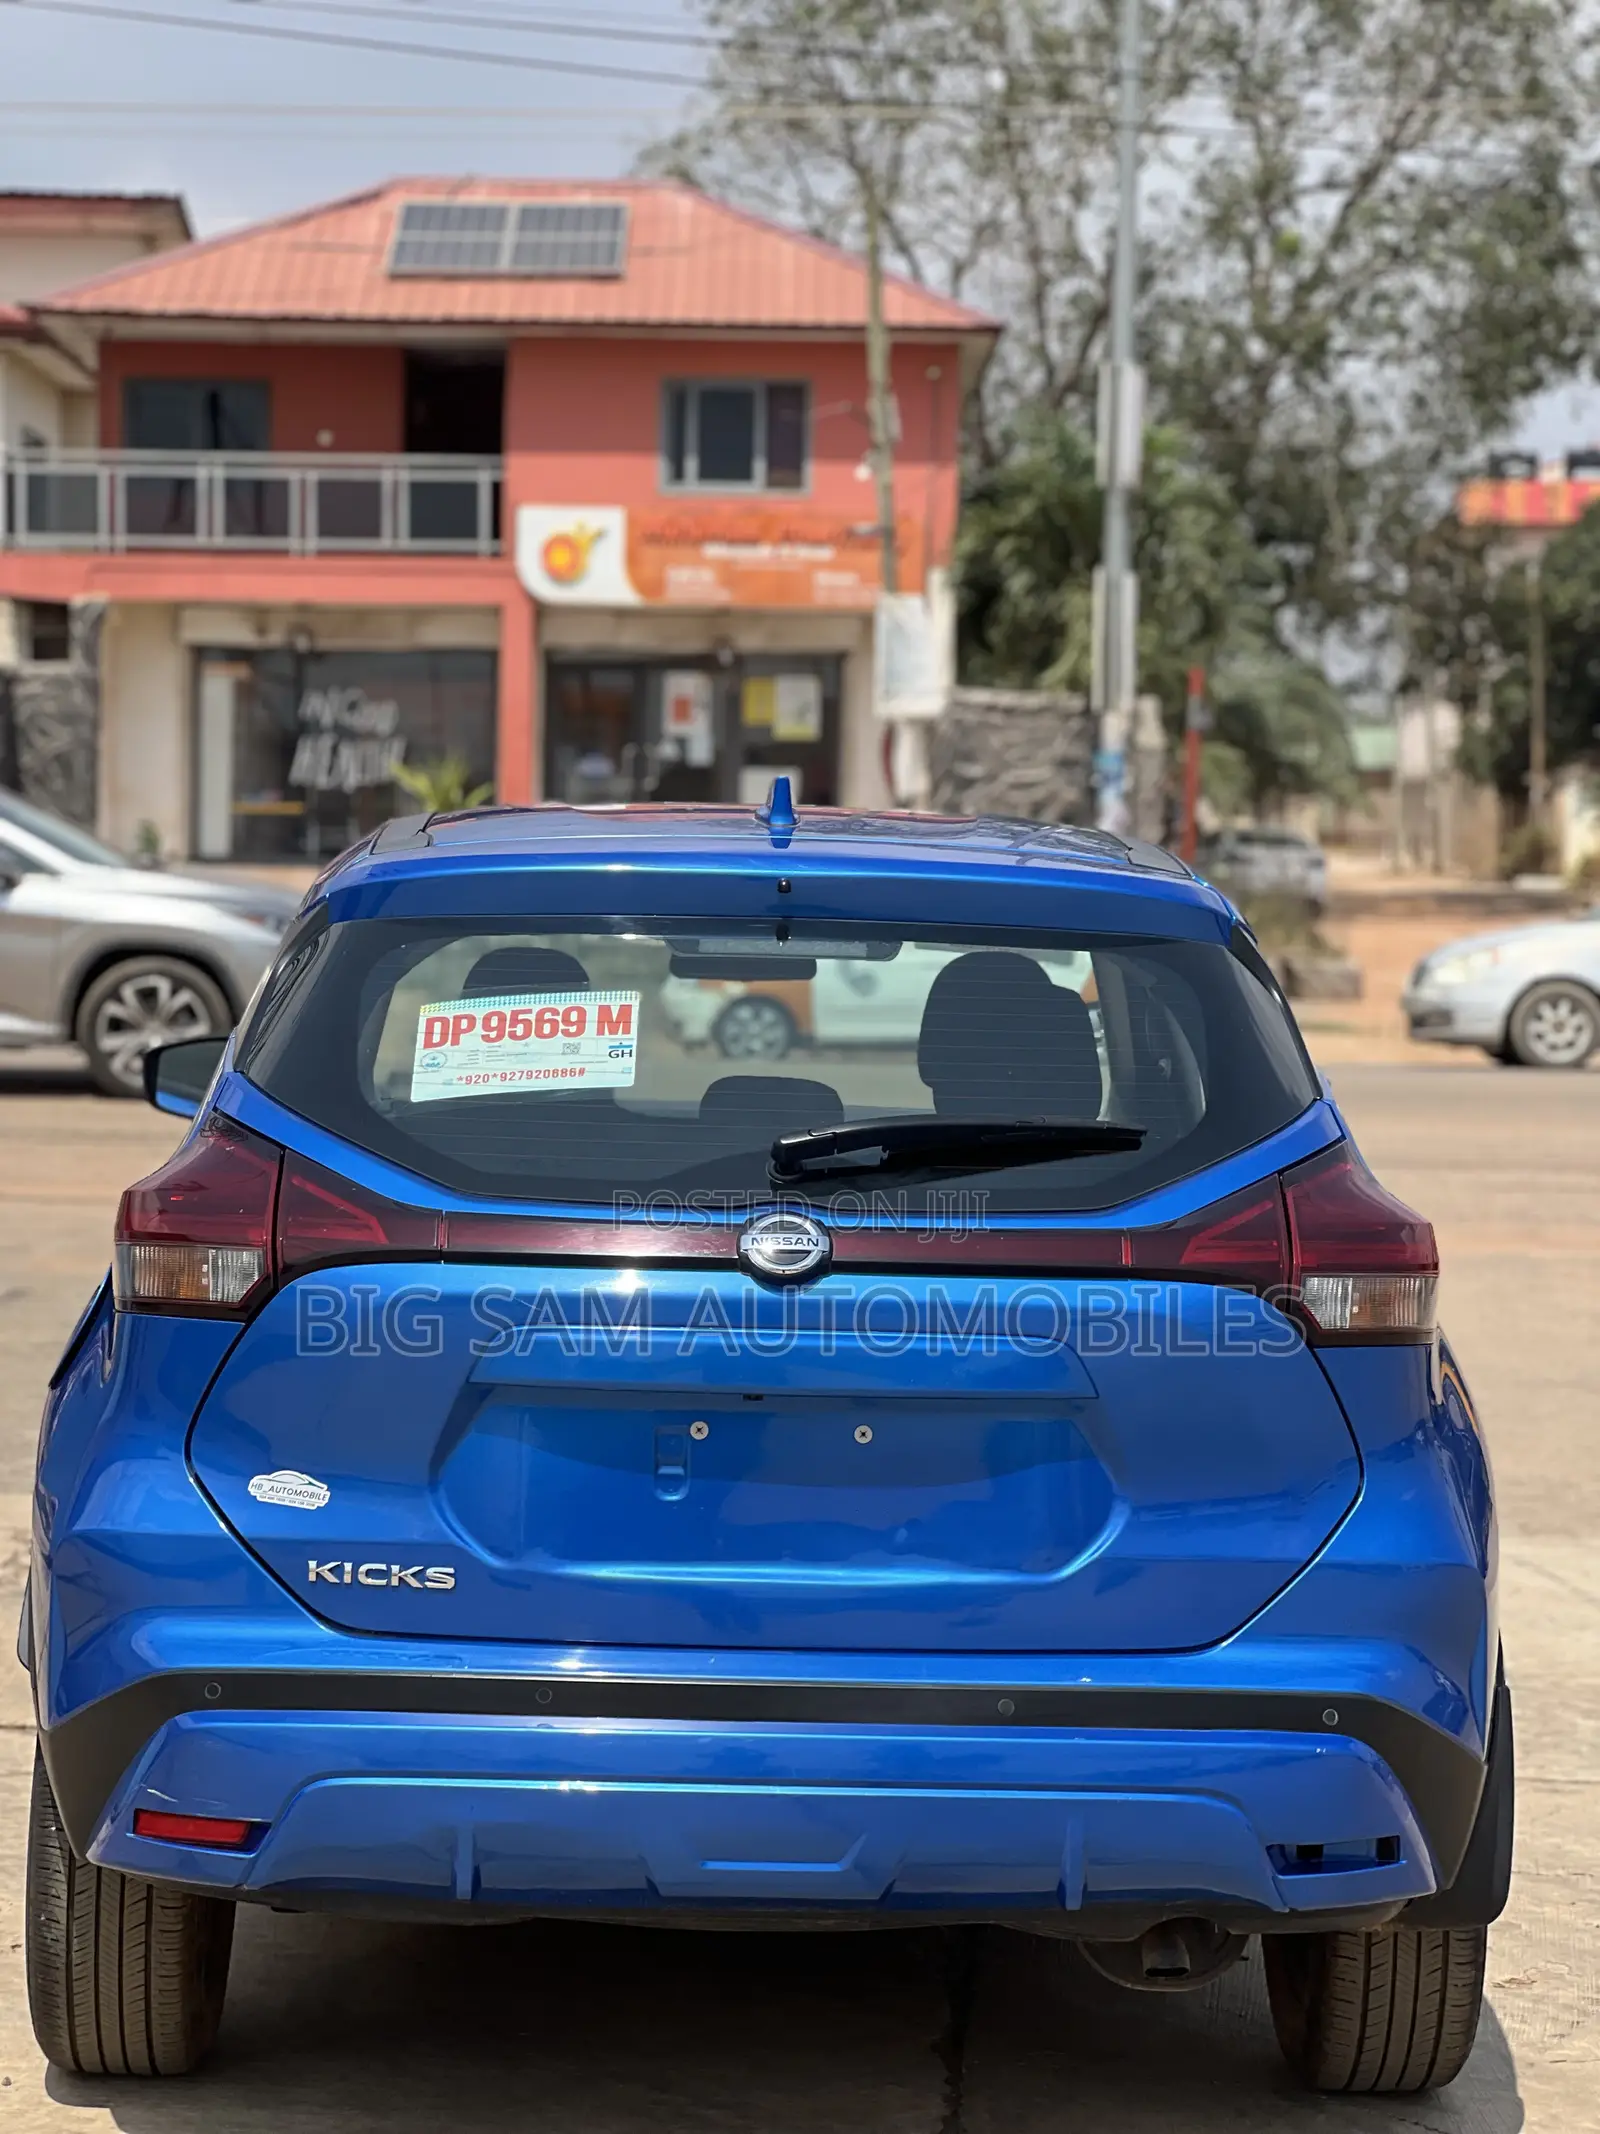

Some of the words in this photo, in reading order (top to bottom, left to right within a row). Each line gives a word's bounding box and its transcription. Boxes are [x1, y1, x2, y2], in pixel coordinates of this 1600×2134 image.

[423, 1013, 477, 1050] DP
[481, 1005, 587, 1044] 9569
[596, 1004, 633, 1036] M
[608, 1049, 633, 1059] GH
[751, 1236, 819, 1247] NISSAN
[307, 1559, 456, 1590] KICKS
